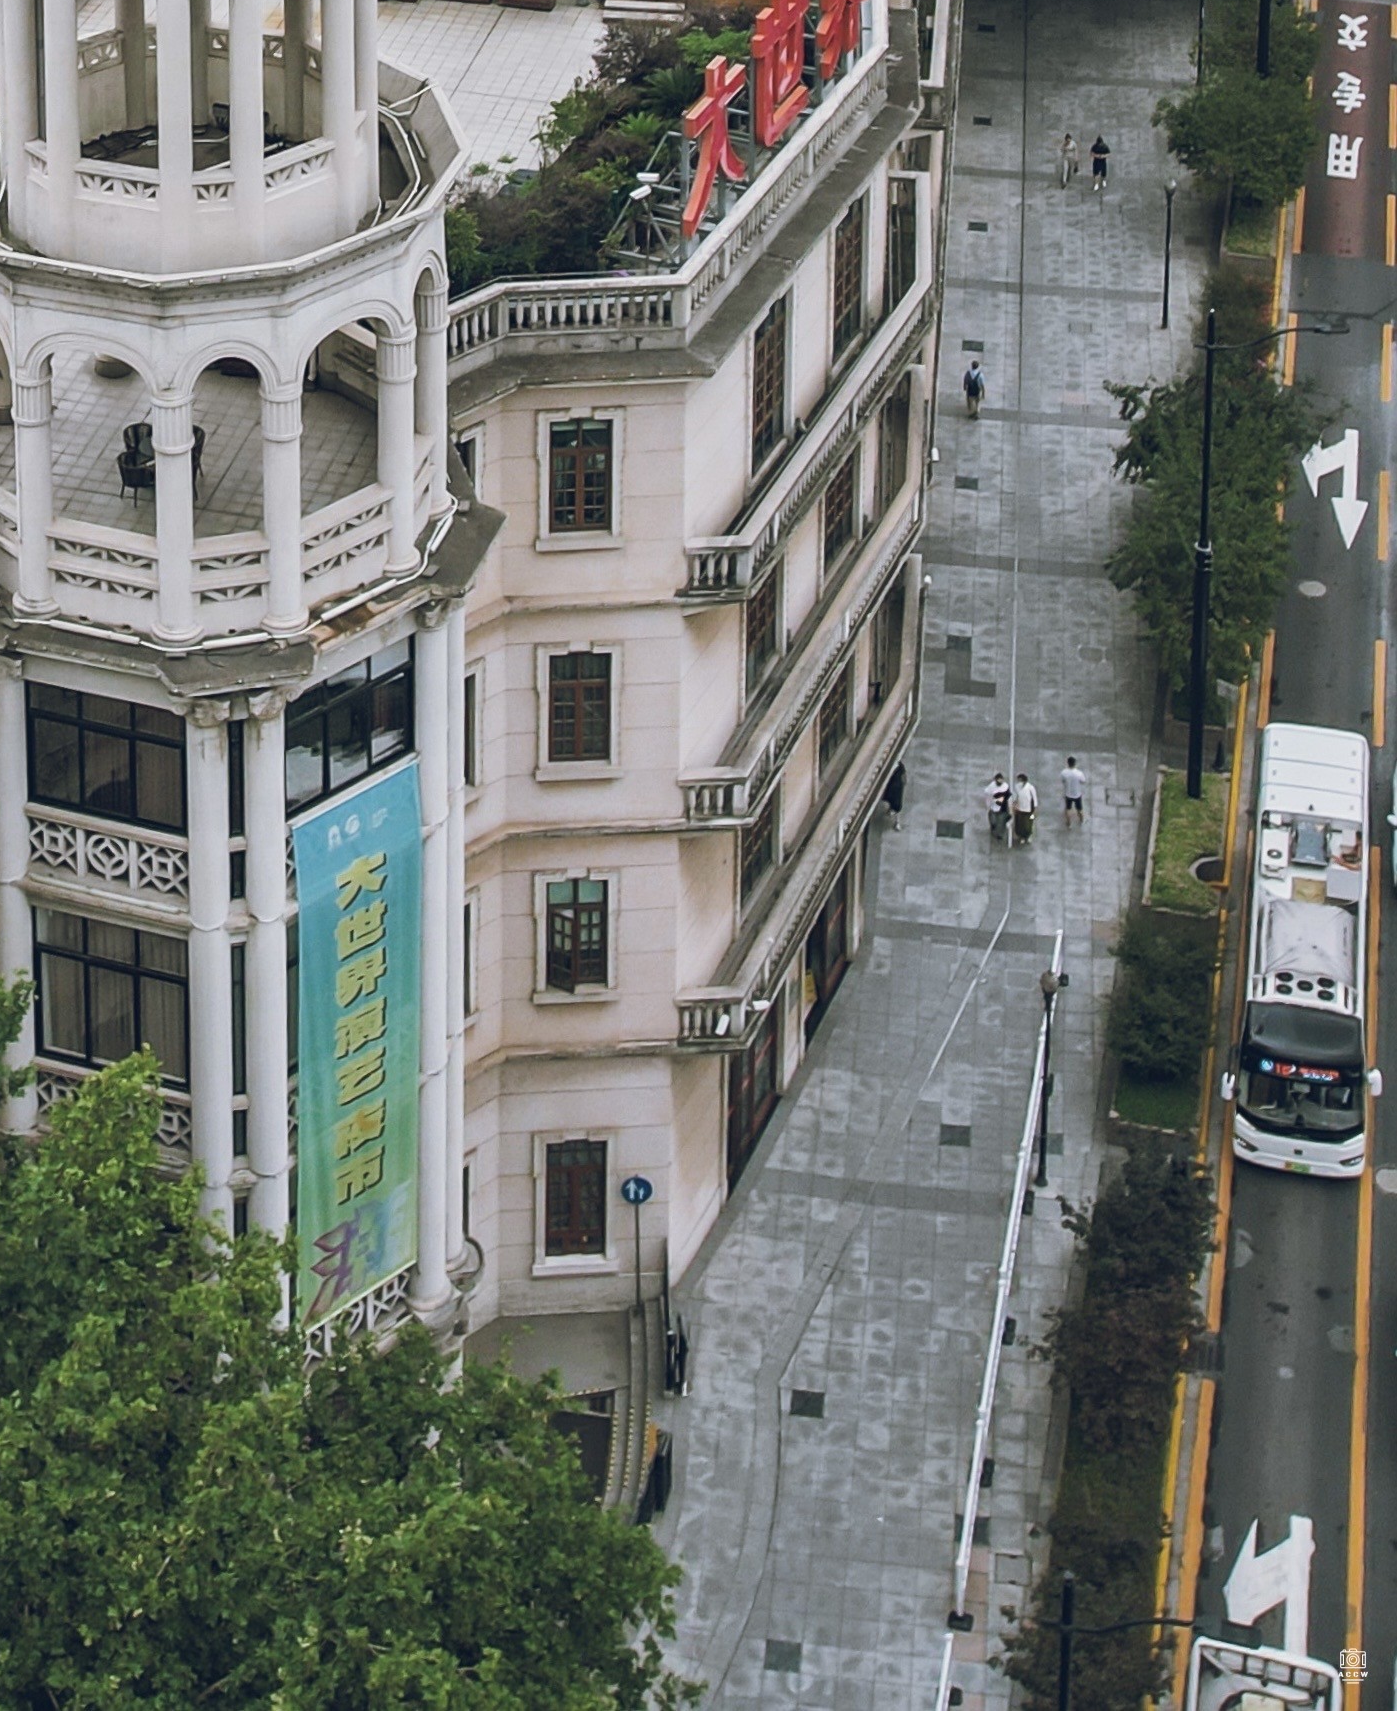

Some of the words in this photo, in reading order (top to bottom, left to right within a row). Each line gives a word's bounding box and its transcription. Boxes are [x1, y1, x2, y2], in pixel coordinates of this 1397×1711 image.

[335, 852, 389, 1206] 大世界演艺夜市
